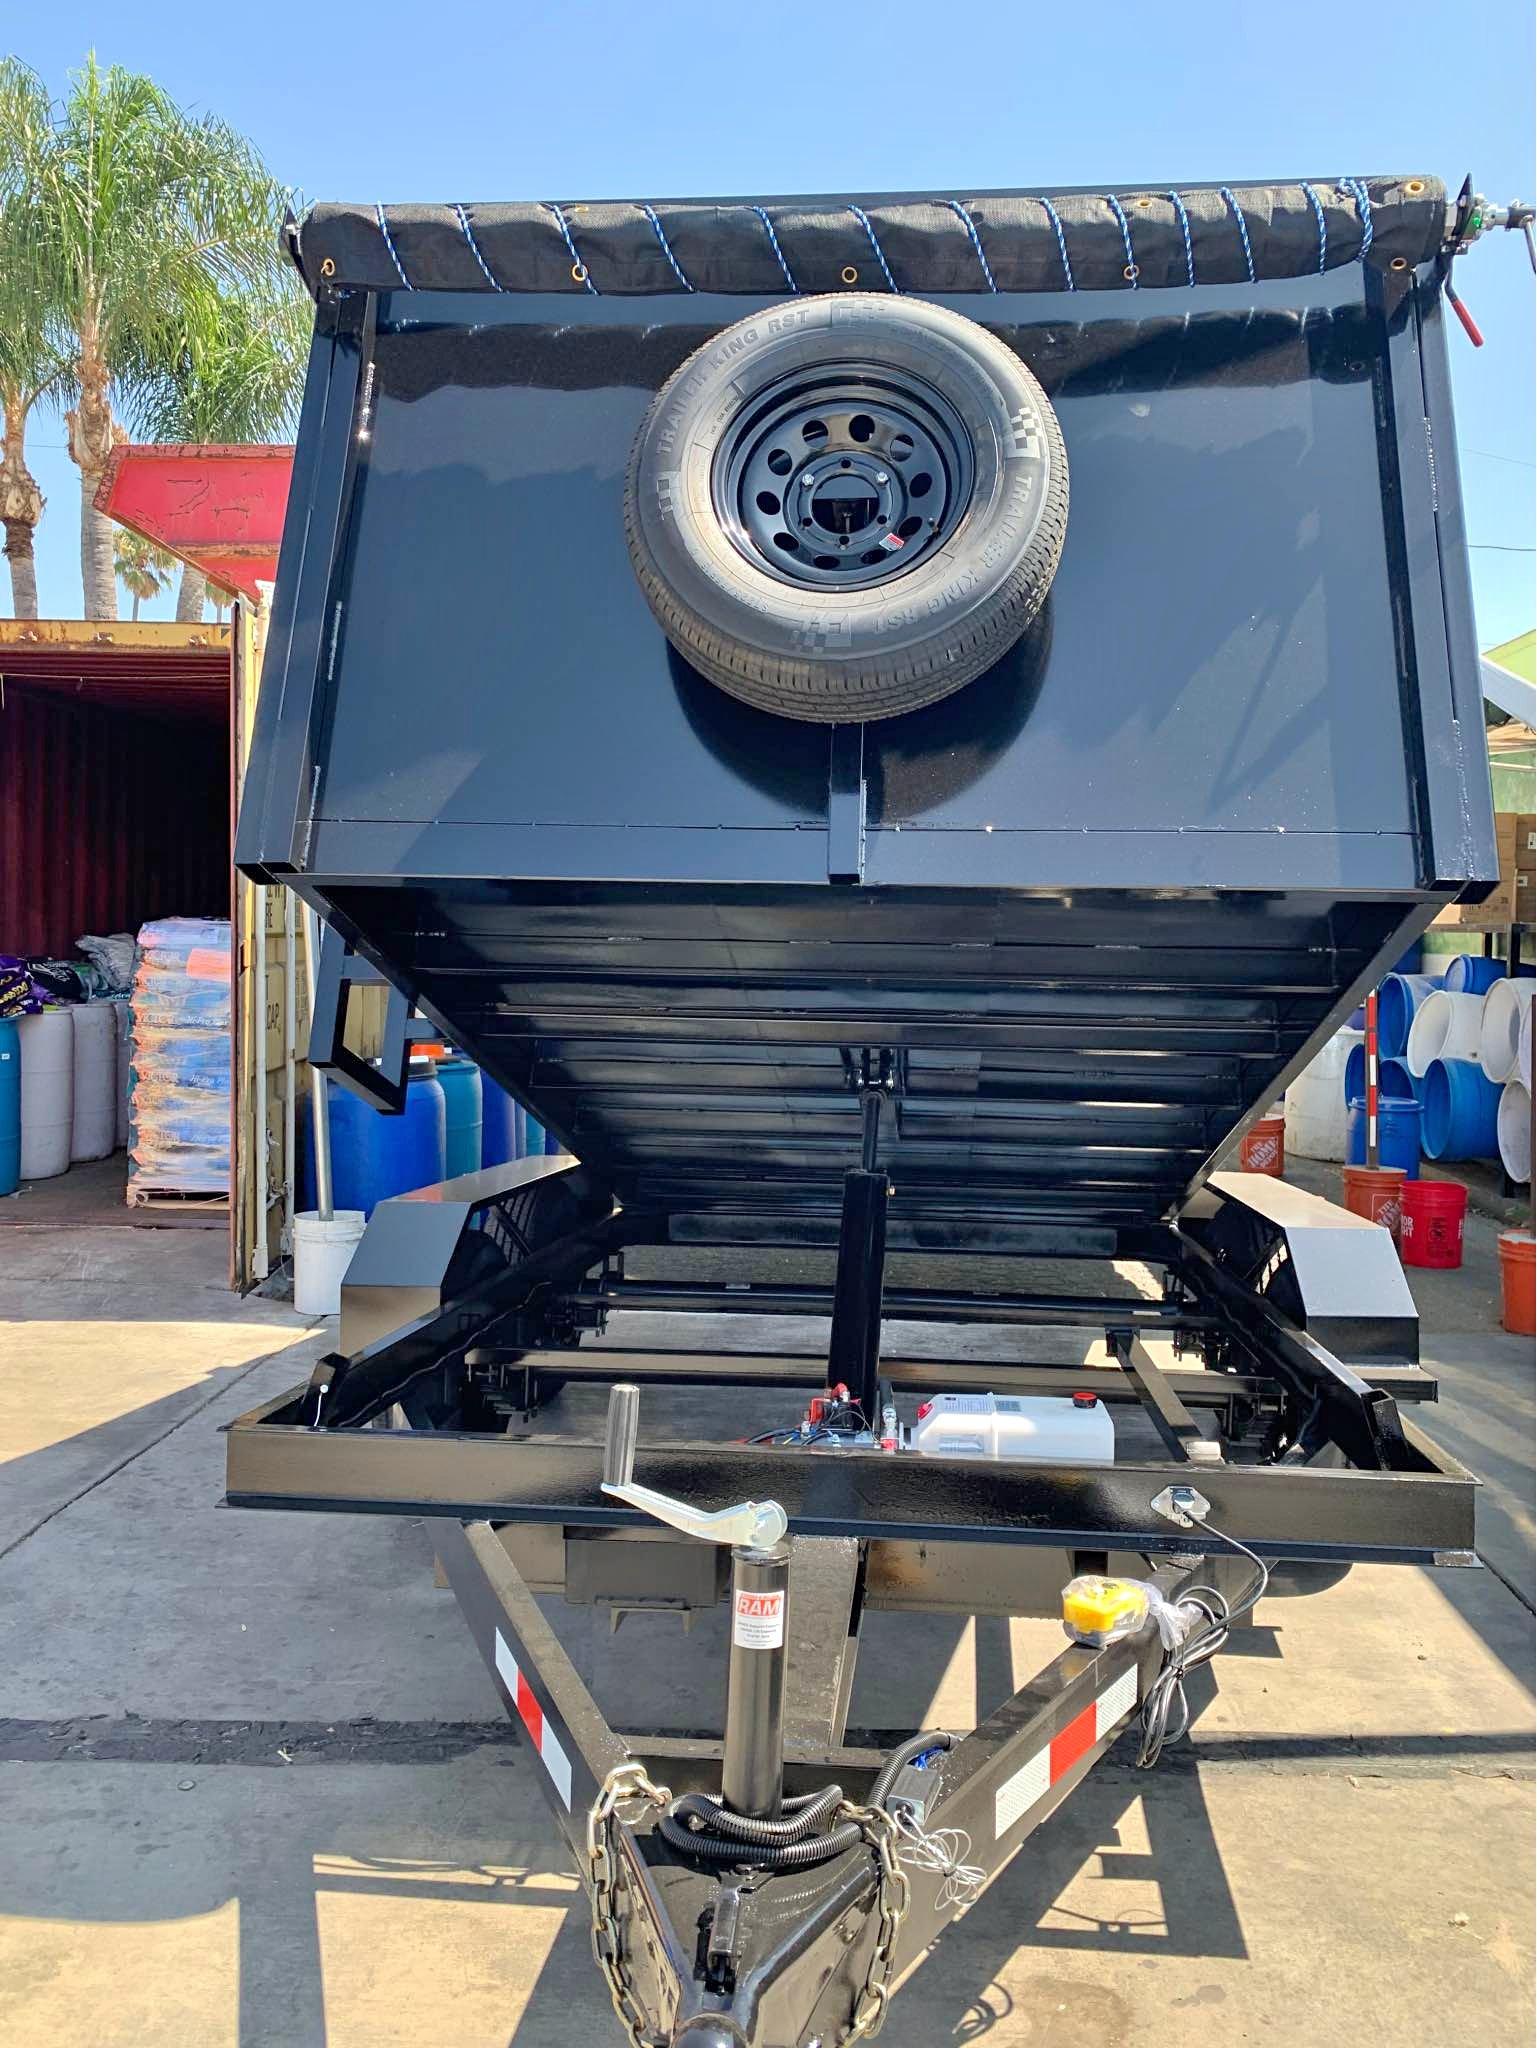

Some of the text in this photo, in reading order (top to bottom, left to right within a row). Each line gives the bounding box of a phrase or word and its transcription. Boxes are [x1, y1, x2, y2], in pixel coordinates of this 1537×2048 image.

[709, 328, 760, 369] KING
[768, 308, 809, 334] RST
[738, 1599, 780, 1616] RAM
